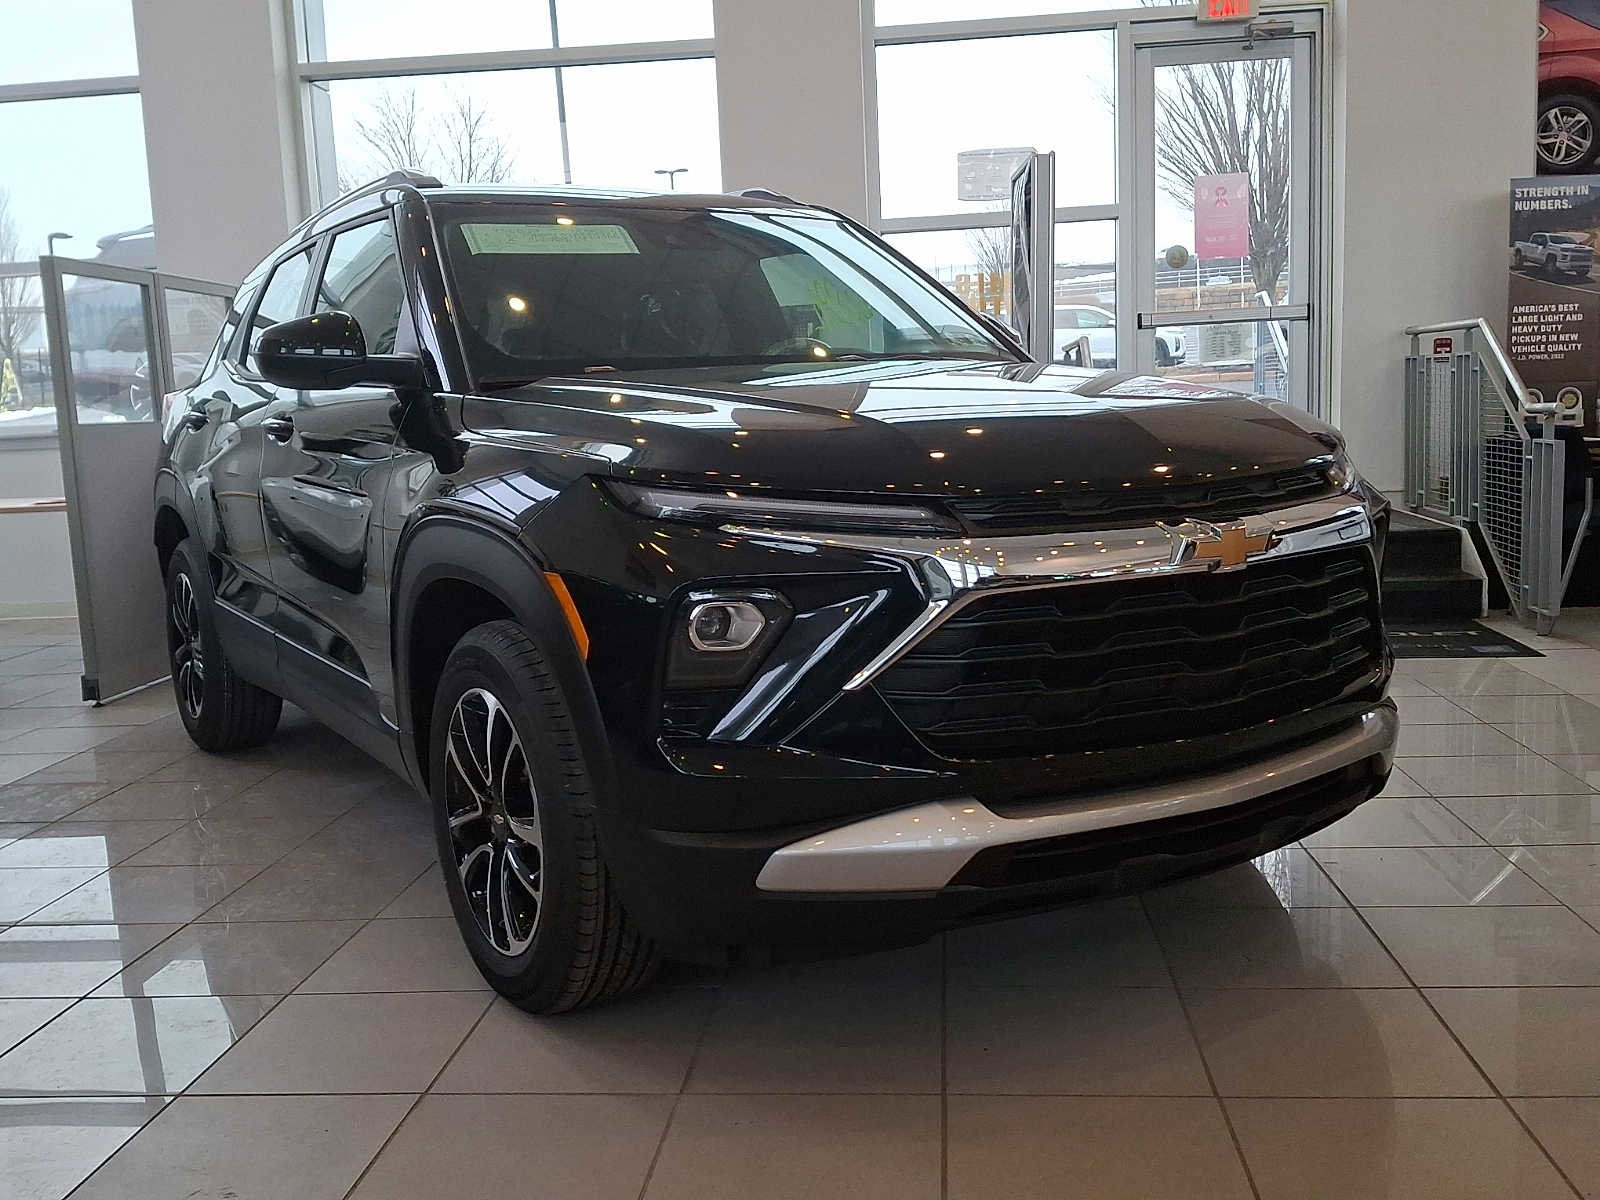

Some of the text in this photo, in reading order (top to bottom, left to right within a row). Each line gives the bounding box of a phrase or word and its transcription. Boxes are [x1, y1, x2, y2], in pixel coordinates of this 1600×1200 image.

[1515, 185, 1589, 198] STRENGTH IN
[1514, 199, 1573, 211] NUMBERS.
[1512, 303, 1579, 313] AMERICA'S BEST
[1512, 313, 1583, 323] LARGE LIGHT AND
[1512, 324, 1563, 333] HEAVY DUTY
[1512, 333, 1579, 343] PICKUPS IN NEW
[1512, 343, 1582, 353] VEHICLE QUALITY
